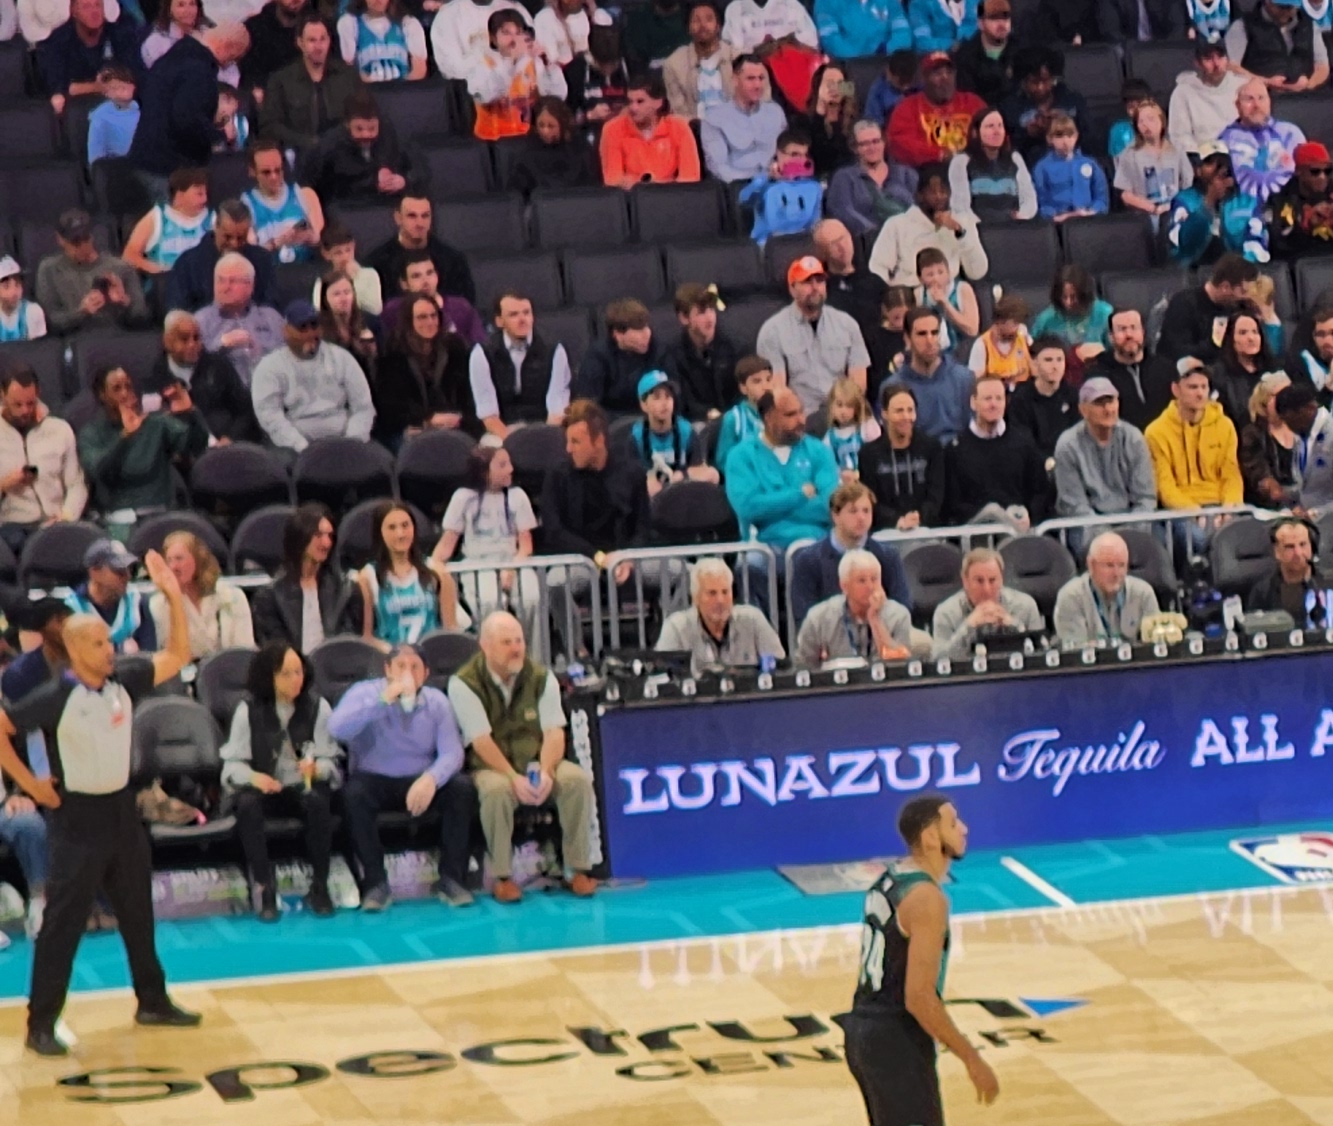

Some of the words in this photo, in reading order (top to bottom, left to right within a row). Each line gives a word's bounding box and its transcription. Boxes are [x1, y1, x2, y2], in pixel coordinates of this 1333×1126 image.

[619, 743, 981, 815] LUNAZUL
[998, 720, 1166, 796] Tequila
[1190, 714, 1294, 767] ALL
[615, 1027, 1060, 1082] CENR
